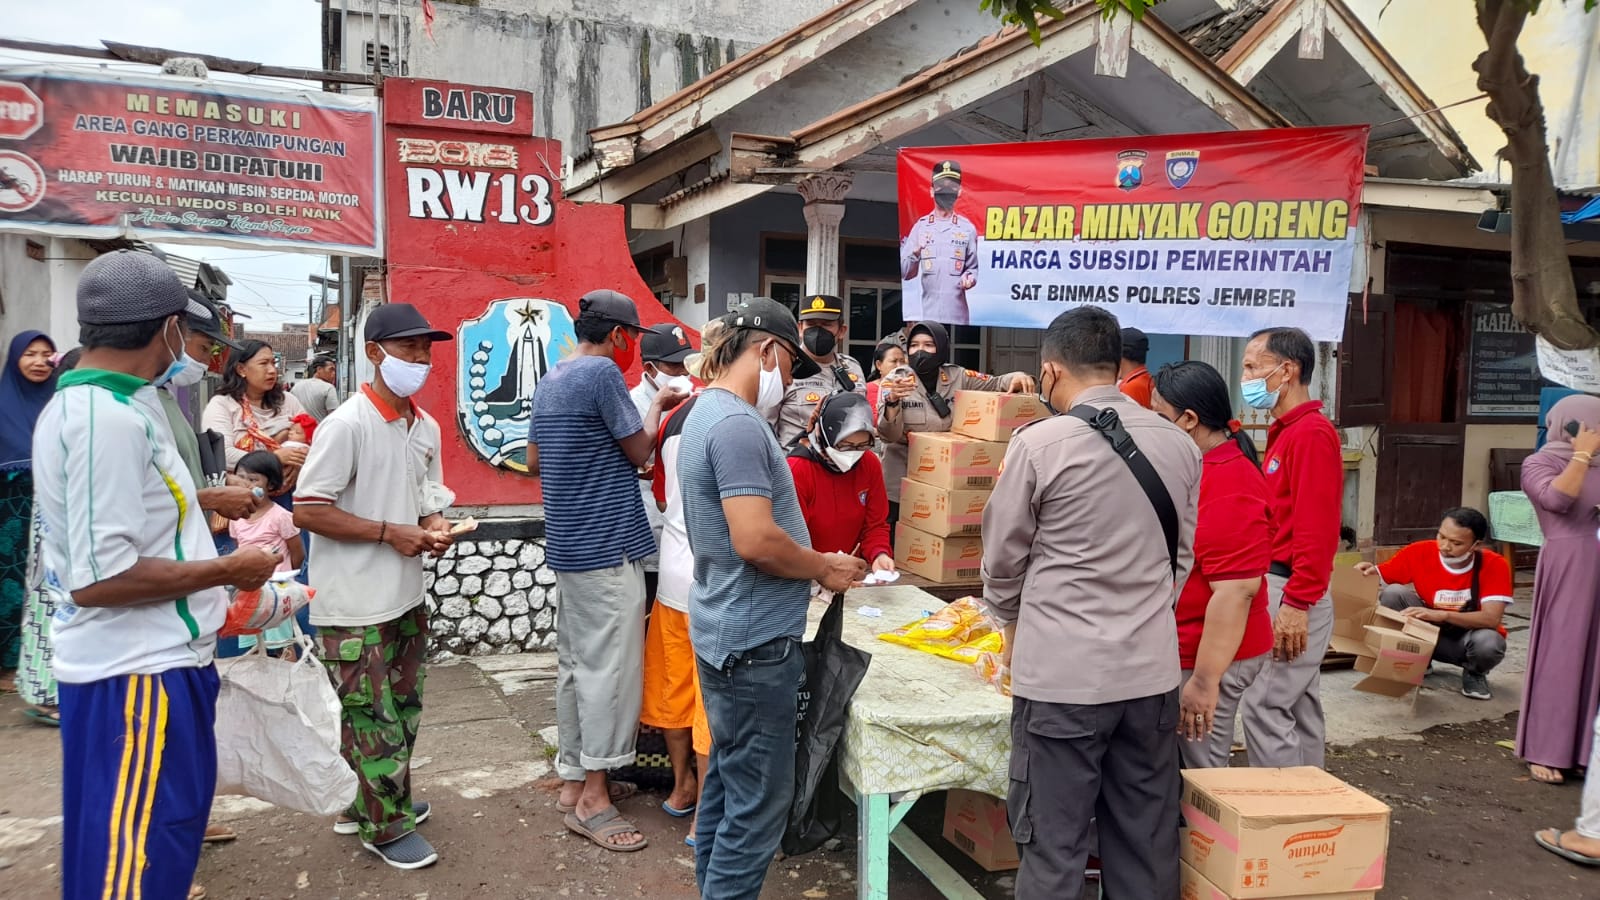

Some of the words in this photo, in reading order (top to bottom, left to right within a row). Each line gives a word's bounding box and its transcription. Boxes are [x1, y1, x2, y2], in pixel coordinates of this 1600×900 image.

[127, 93, 302, 129] MEMASUKI
[423, 88, 516, 124] BARU
[75, 114, 127, 134] AREA
[133, 120, 189, 140] GANG
[194, 126, 346, 157] PERKAMPUNGAN
[110, 144, 199, 170] WAJIB
[205, 152, 323, 182] DIPATUHI
[58, 169, 103, 185] HARAP
[106, 173, 151, 188] TURUN
[155, 176, 164, 189] &
[168, 177, 225, 194] MATIKAN
[228, 182, 267, 197] MESIN
[270, 185, 315, 202] SEPEDA
[319, 190, 359, 207] MOTOR
[96, 190, 171, 206] KECUALI
[177, 196, 238, 212] WEDOS
[242, 201, 297, 218] BOLEH
[303, 207, 341, 221] NAIK
[131, 208, 180, 225] Anda
[227, 215, 268, 233] Kami
[269, 219, 314, 235] Segan
[983, 203, 1075, 242] BAZAR
[1080, 202, 1203, 241] MINYAK
[1206, 198, 1350, 240] GORENG
[991, 249, 1062, 270] HARGA
[1067, 250, 1159, 271] SUBSIDI
[1166, 250, 1332, 273] PEMERINTAH
[1010, 284, 1044, 302] SAT
[1047, 284, 1120, 304] BINMAS
[1126, 286, 1201, 306] POLRES
[1207, 287, 1296, 308] JEMBER
[1288, 841, 1336, 860] Fortune
